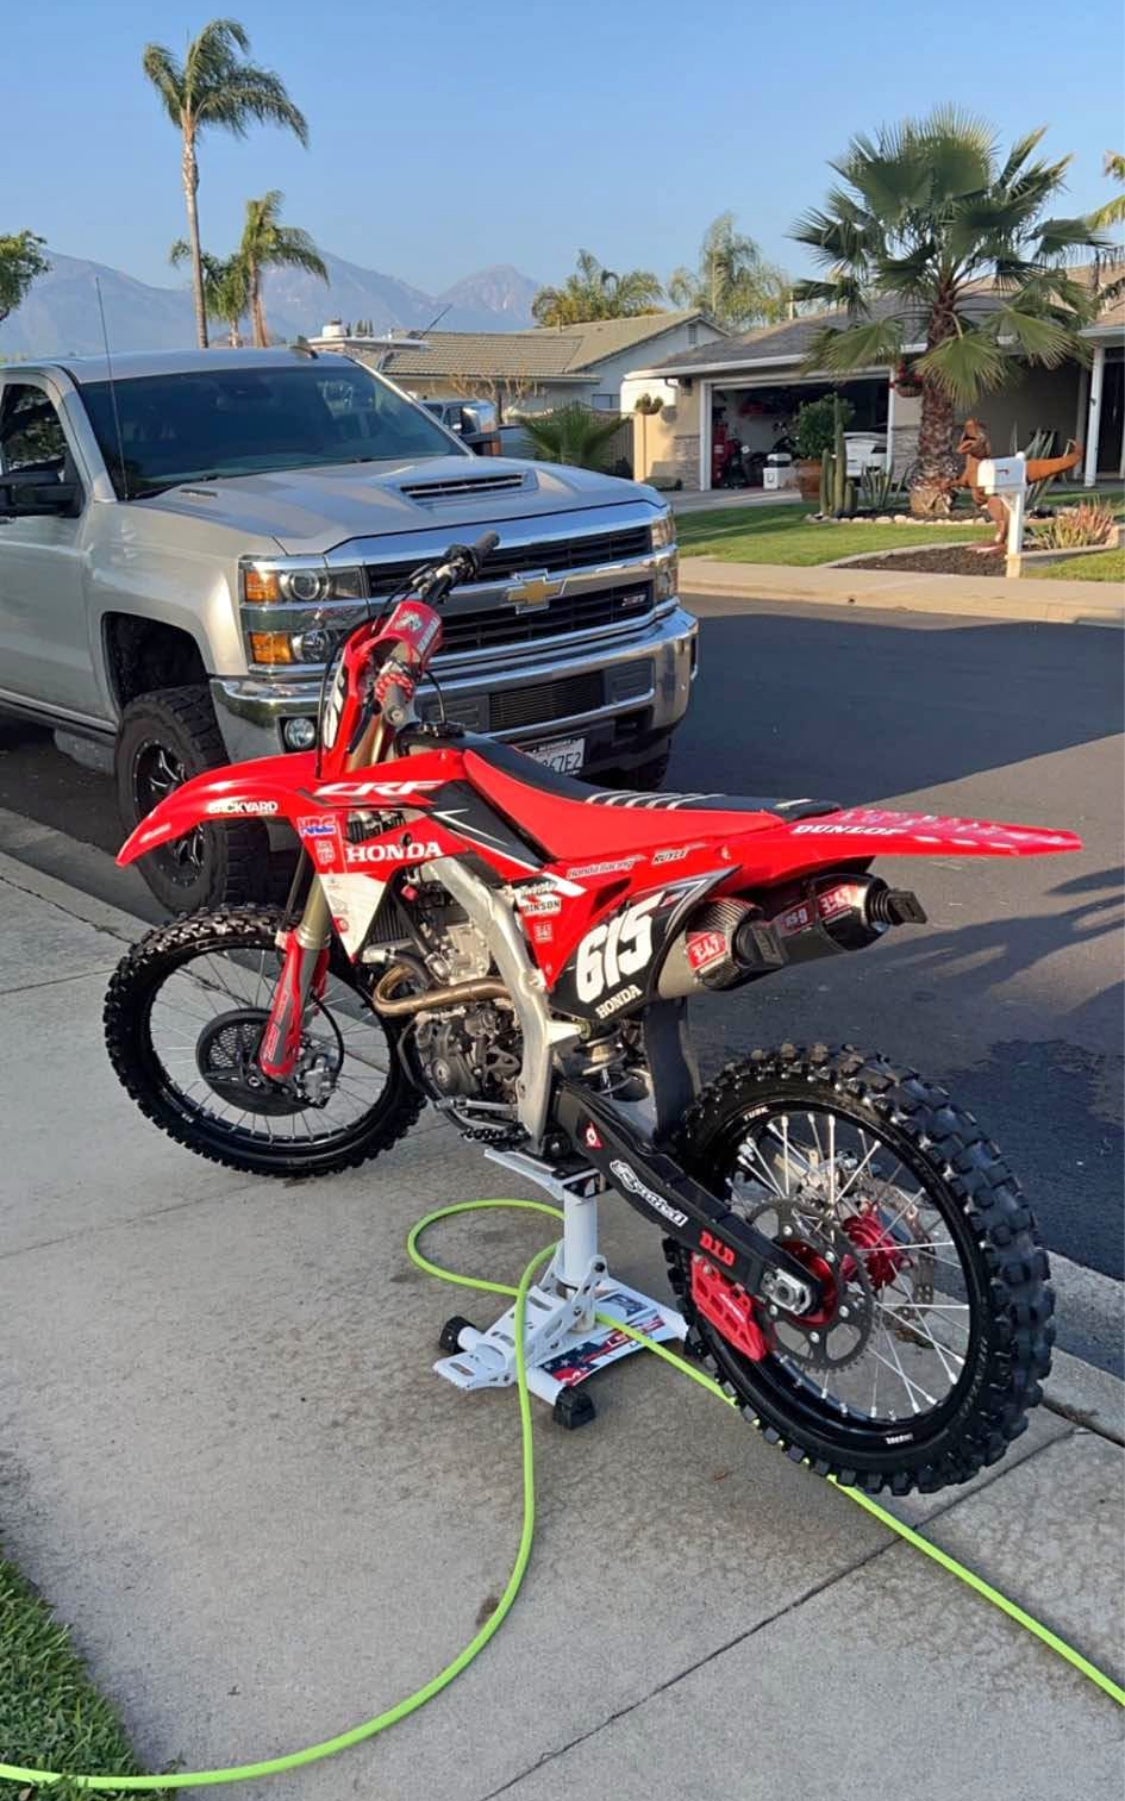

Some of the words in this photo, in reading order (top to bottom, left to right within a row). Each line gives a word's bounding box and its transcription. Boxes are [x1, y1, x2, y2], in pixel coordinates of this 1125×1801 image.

[313, 780, 445, 796] CRF
[346, 842, 444, 863] HONDA
[576, 890, 666, 1005] 615
[595, 984, 643, 1019] HONDA
